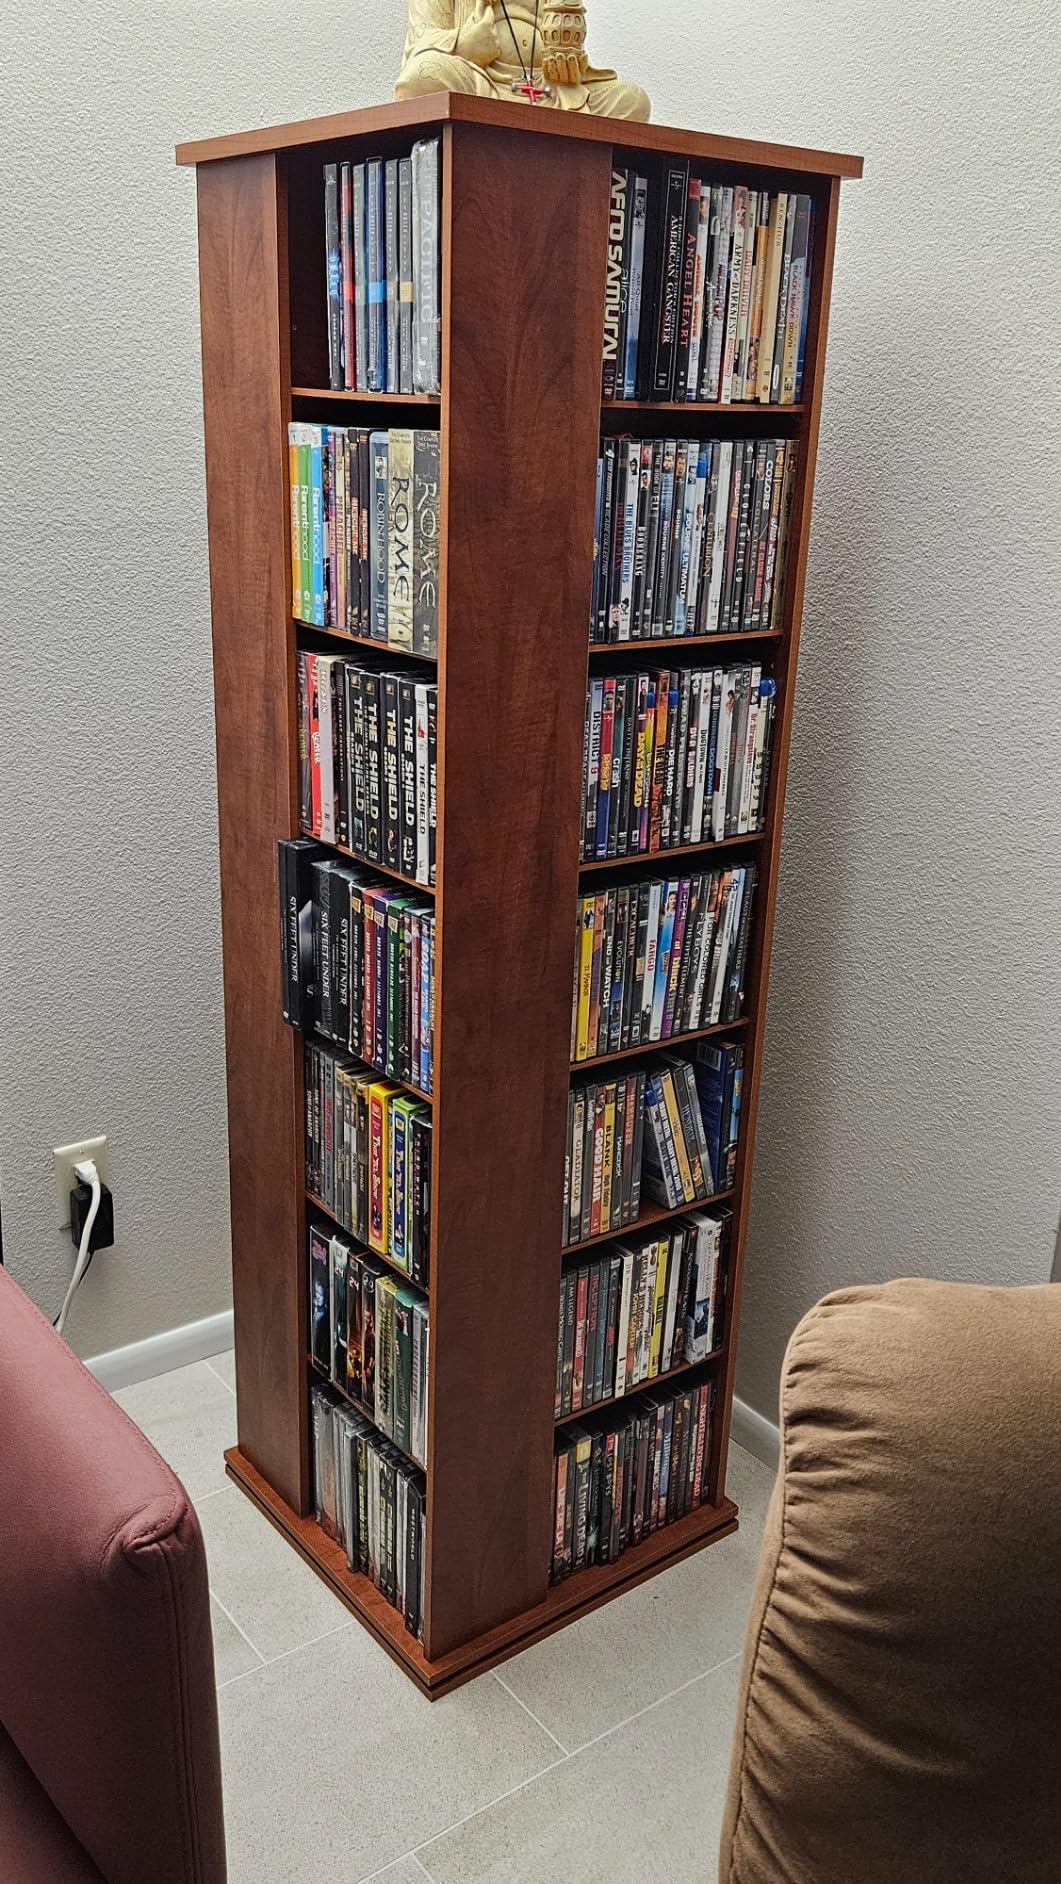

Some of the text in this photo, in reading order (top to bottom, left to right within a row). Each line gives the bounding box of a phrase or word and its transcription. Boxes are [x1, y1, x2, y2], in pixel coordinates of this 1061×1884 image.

[775, 203, 784, 247] BEN-HUR
[420, 200, 433, 322] PACIFIC
[603, 171, 627, 359] AFRO SAMURAI
[620, 268, 629, 313] alice
[662, 215, 679, 343] AMERICAN GANGSTER
[680, 232, 697, 348] ANGEL HEART
[728, 243, 743, 336] ARMY DARKNESS
[740, 250, 752, 317] BABY DRIVER
[791, 265, 799, 291] BLACK
[778, 254, 791, 339] BLACK DEATH
[788, 293, 797, 319] HAWK
[787, 322, 796, 348] DOWN
[292, 434, 296, 442] 1
[605, 449, 615, 457] 4
[651, 495, 659, 511] ELI
[763, 460, 773, 510] COLORS
[292, 485, 300, 560] Parenthood
[300, 485, 310, 561] Parenthood
[312, 487, 321, 565] Parenthood
[376, 492, 386, 583] ROBIN HOOD
[390, 476, 410, 603] ROME
[417, 480, 437, 609] ROME
[622, 504, 634, 584] THE BLUES BROTHERS
[635, 526, 646, 576] BOOMERANG
[661, 520, 669, 550] BOURNE
[703, 512, 715, 577] CENTURION
[736, 483, 750, 583] CLOVERFIELD
[750, 500, 761, 574] COLLATERAL
[602, 533, 610, 576] COLLECTION
[679, 513, 693, 604] BOURNE ULTIMATUM
[754, 541, 766, 602] AT CLOSE RANGE
[354, 696, 364, 811] THE SHIELD
[369, 702, 379, 820] THE SHIELD
[387, 709, 397, 820] THE SHIELD
[404, 715, 414, 826] THE SHIELD
[591, 711, 600, 775] DISTRICT 9
[611, 757, 621, 788] crash
[633, 732, 646, 807] DAY DEAD
[666, 749, 676, 796] DIE HARD
[687, 751, 696, 788] SOLDIERS
[699, 729, 707, 763] DOGTOWN
[706, 748, 715, 796] DOGTOWN
[747, 724, 757, 764] Strangelove
[289, 896, 298, 983] SIX FEET UNDER
[321, 911, 330, 999] SIX FEET UNDER
[627, 899, 637, 957] EXCALIBUR
[648, 939, 657, 972] FARGO
[684, 941, 692, 963] FIFTH
[690, 911, 704, 974] FLYBOYS
[735, 938, 745, 969] FATHERS
[339, 918, 348, 1006] SIX FEET UNDER
[603, 965, 611, 1008] WATCH
[615, 940, 623, 983] EVOLUTION
[669, 956, 680, 992] black
[678, 964, 688, 1000] ELEMENT
[700, 937, 711, 980] COLORED
[604, 1125, 612, 1168] BLANK
[625, 1095, 633, 1146] HANGOVER
[372, 1135, 381, 1200] That Show
[395, 1150, 403, 1170] That
[593, 1128, 603, 1202] GOOD HAIR
[349, 1276, 359, 1291] 24
[568, 1287, 573, 1298] AM
[590, 1273, 599, 1332] INCEPTION
[636, 1255, 648, 1332] KELLY'S HEROES
[629, 1316, 637, 1348] CARTER
[694, 1404, 707, 1497] NIGHT LIVING DEAD
[604, 1474, 612, 1496] BOYS
[576, 1483, 589, 1556] LIVING DEAD
